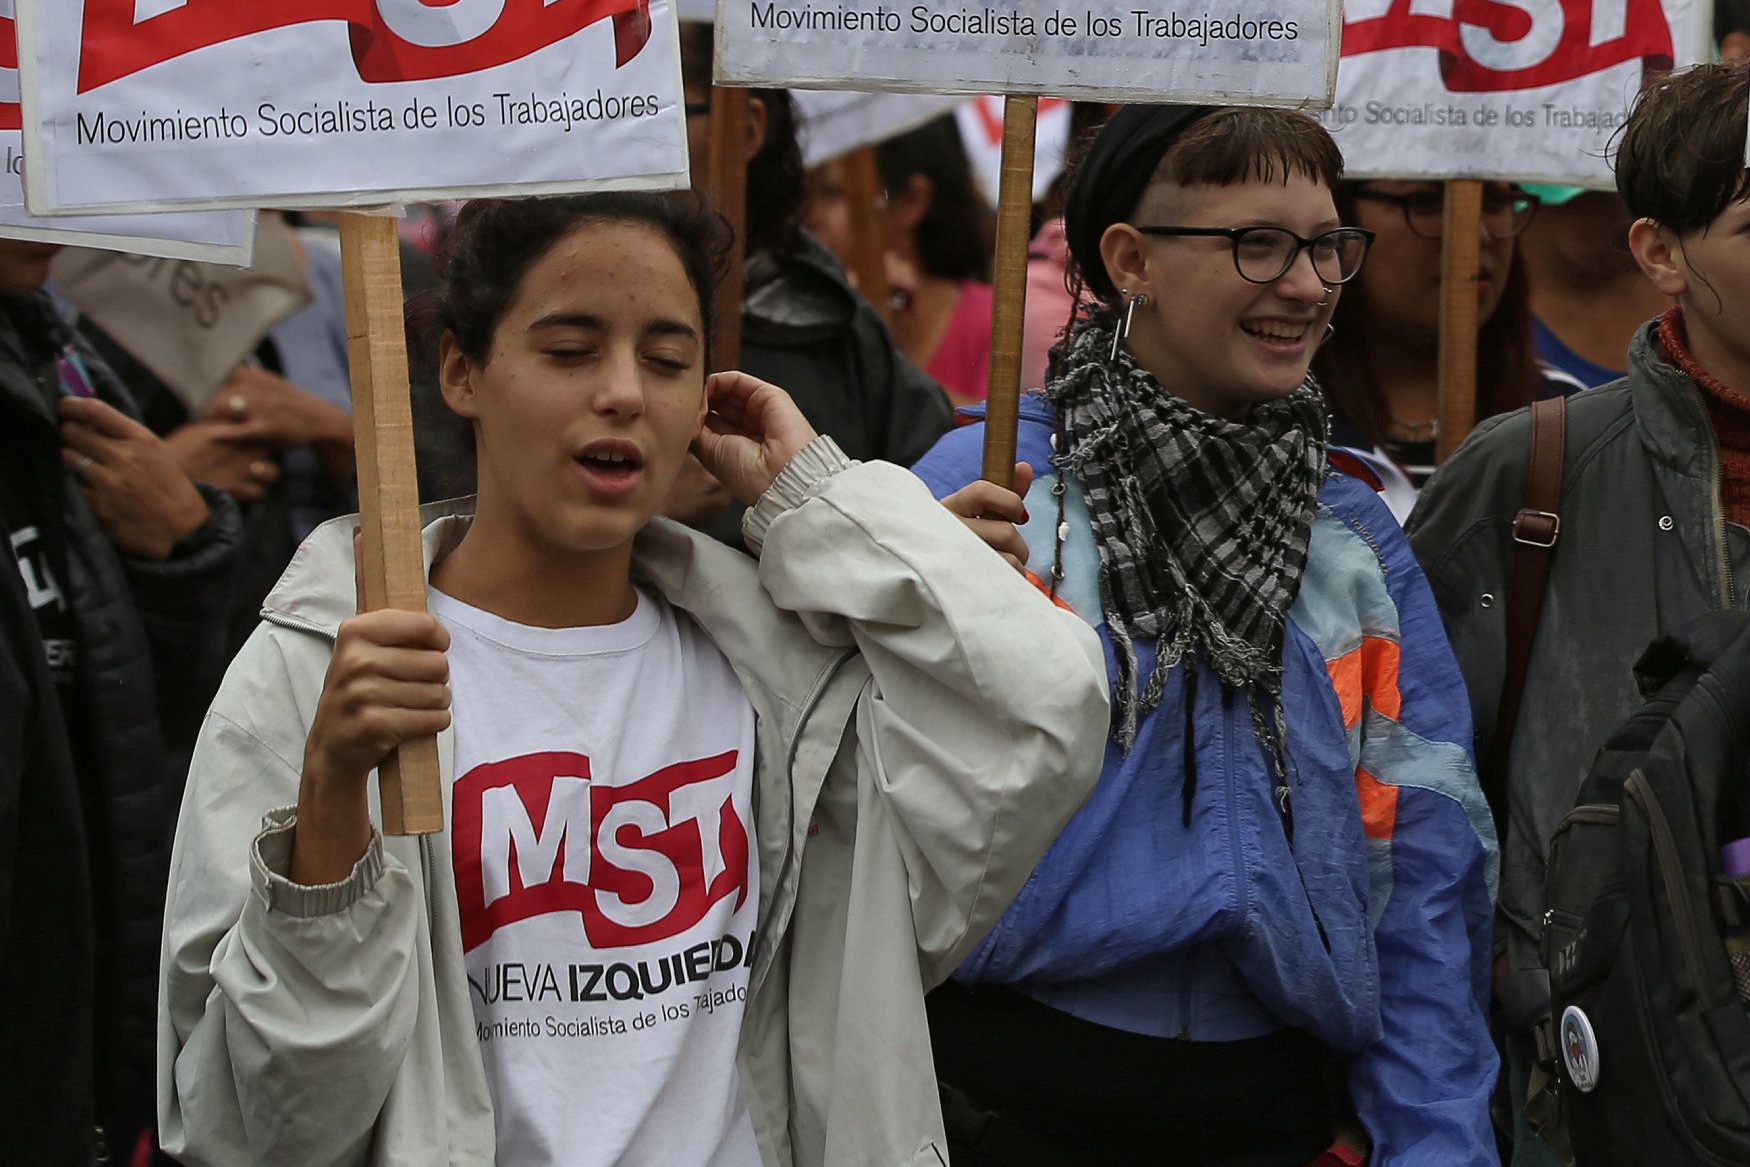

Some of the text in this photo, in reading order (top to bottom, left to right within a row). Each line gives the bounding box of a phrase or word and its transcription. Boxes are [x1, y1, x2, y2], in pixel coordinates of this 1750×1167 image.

[750, 0, 1299, 46] Movimiento Socialista de los Trabajadores
[76, 89, 660, 145] Movimiento Socialista de los Trabajadores
[1364, 99, 1467, 127] Socialista
[1472, 101, 1497, 127] de
[1505, 103, 1535, 128] los
[480, 769, 736, 928] MST
[545, 1015, 628, 1038] Socialista
[632, 1011, 657, 1031] de
[661, 1003, 691, 1022] los
